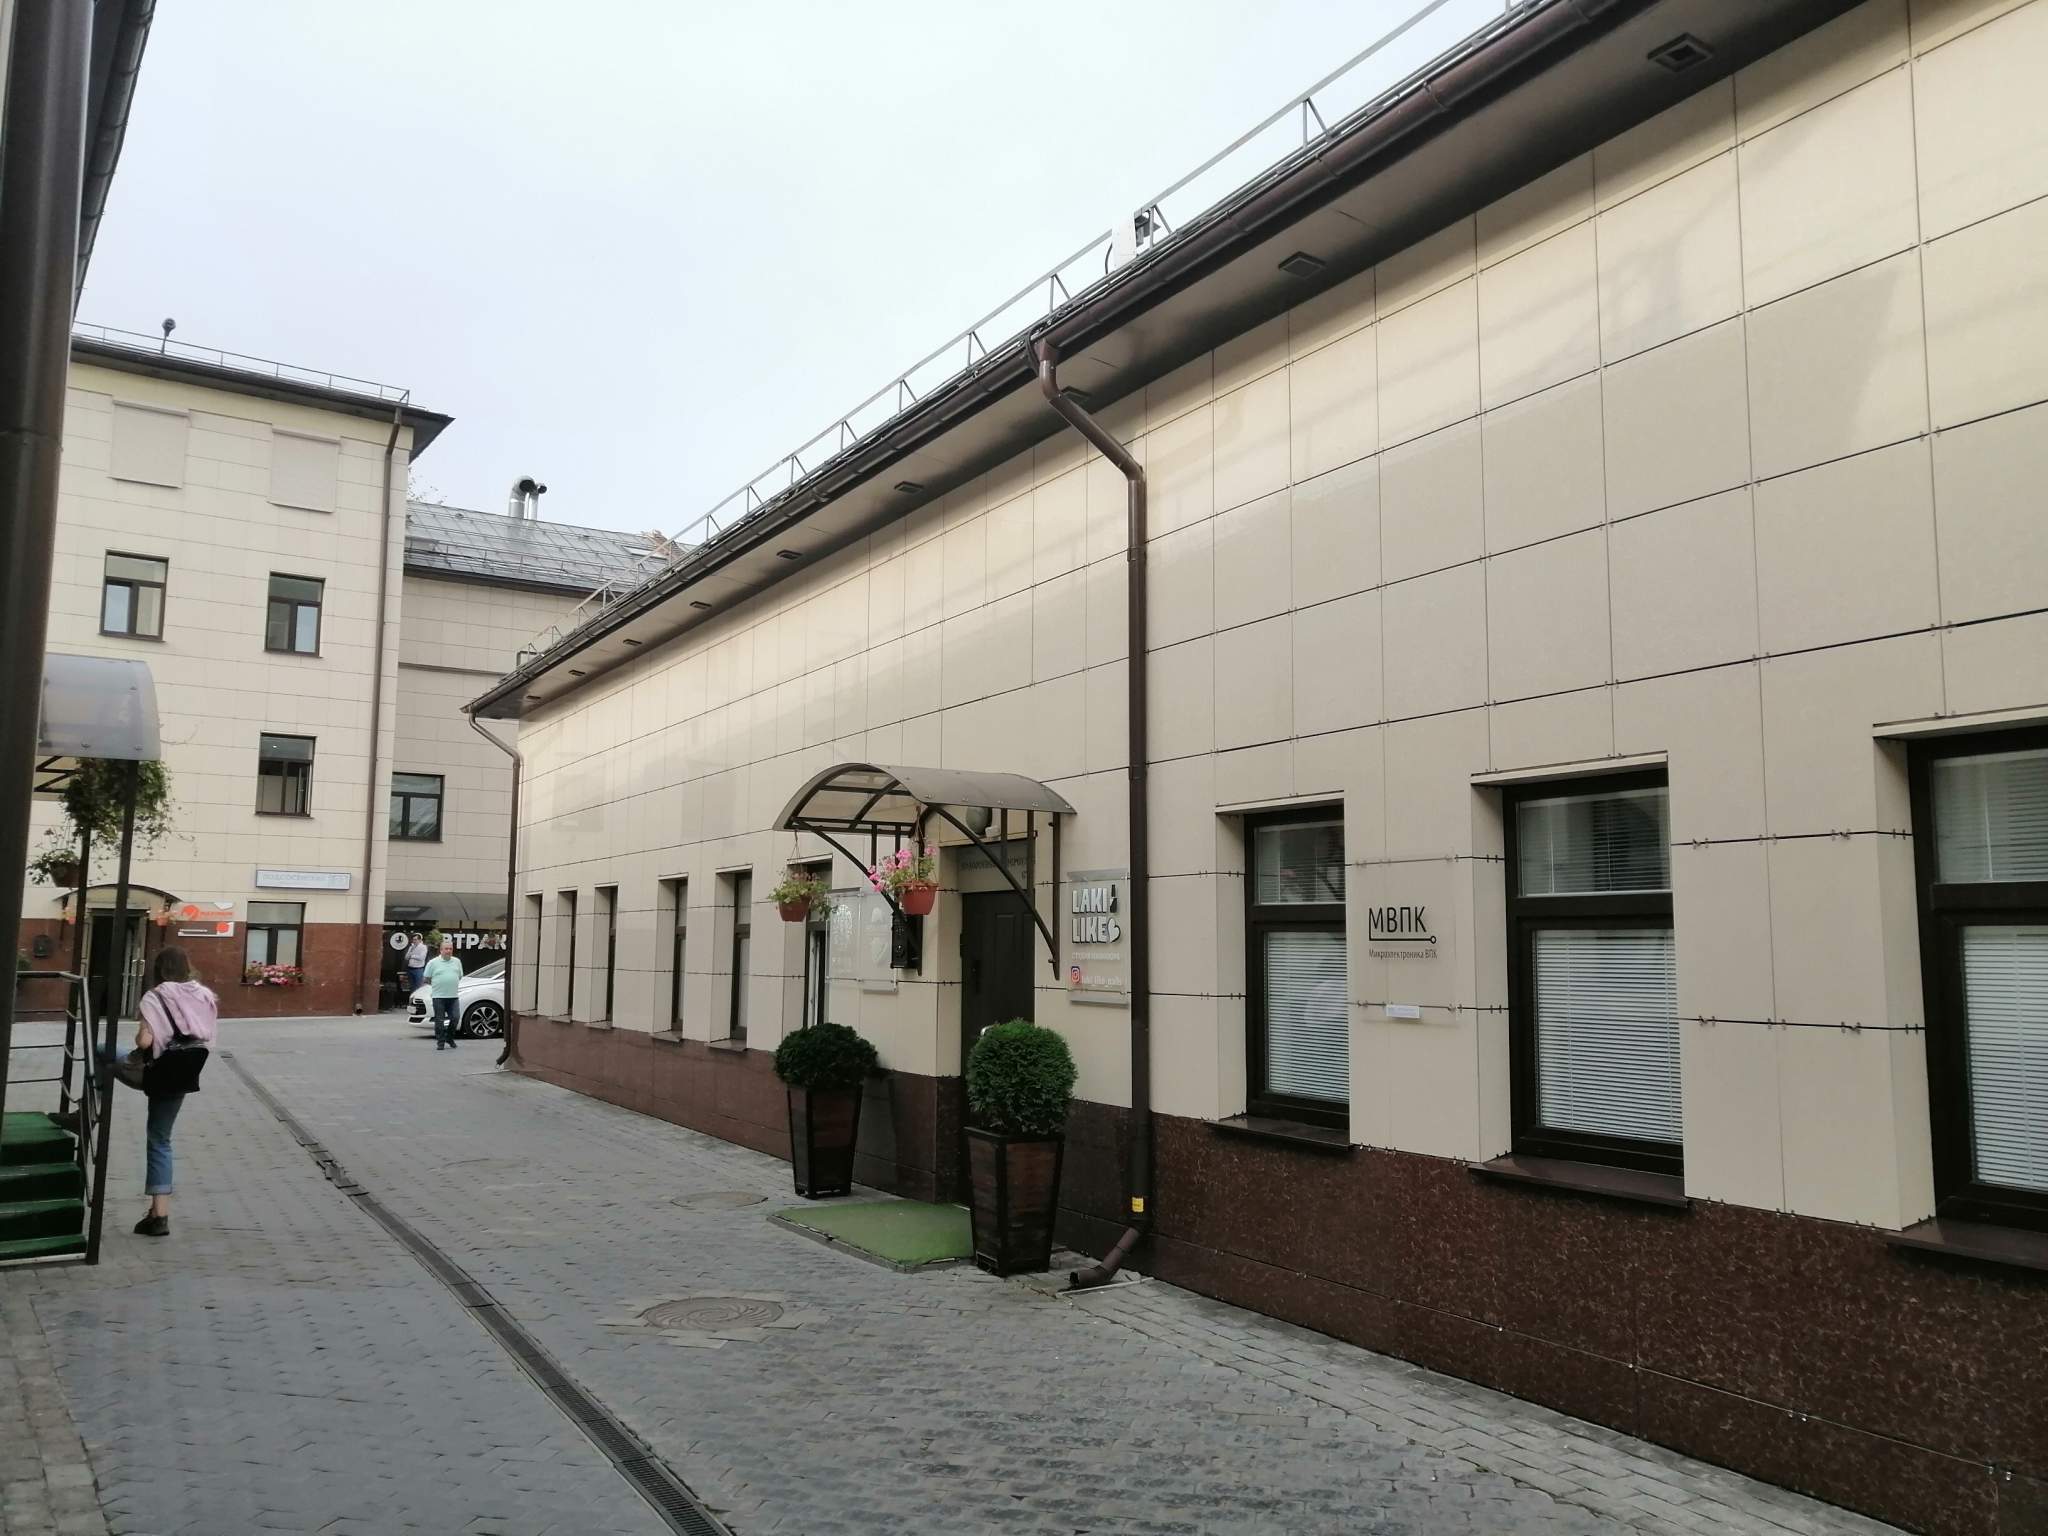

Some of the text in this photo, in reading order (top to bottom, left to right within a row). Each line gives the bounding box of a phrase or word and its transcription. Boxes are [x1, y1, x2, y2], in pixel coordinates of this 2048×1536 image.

[1071, 887, 1107, 913] LAKI
[1071, 916, 1108, 943] LIKE
[1369, 906, 1427, 933] МВПК
[411, 932, 507, 950] ВТРАК
[1425, 948, 1438, 960] ВПК
